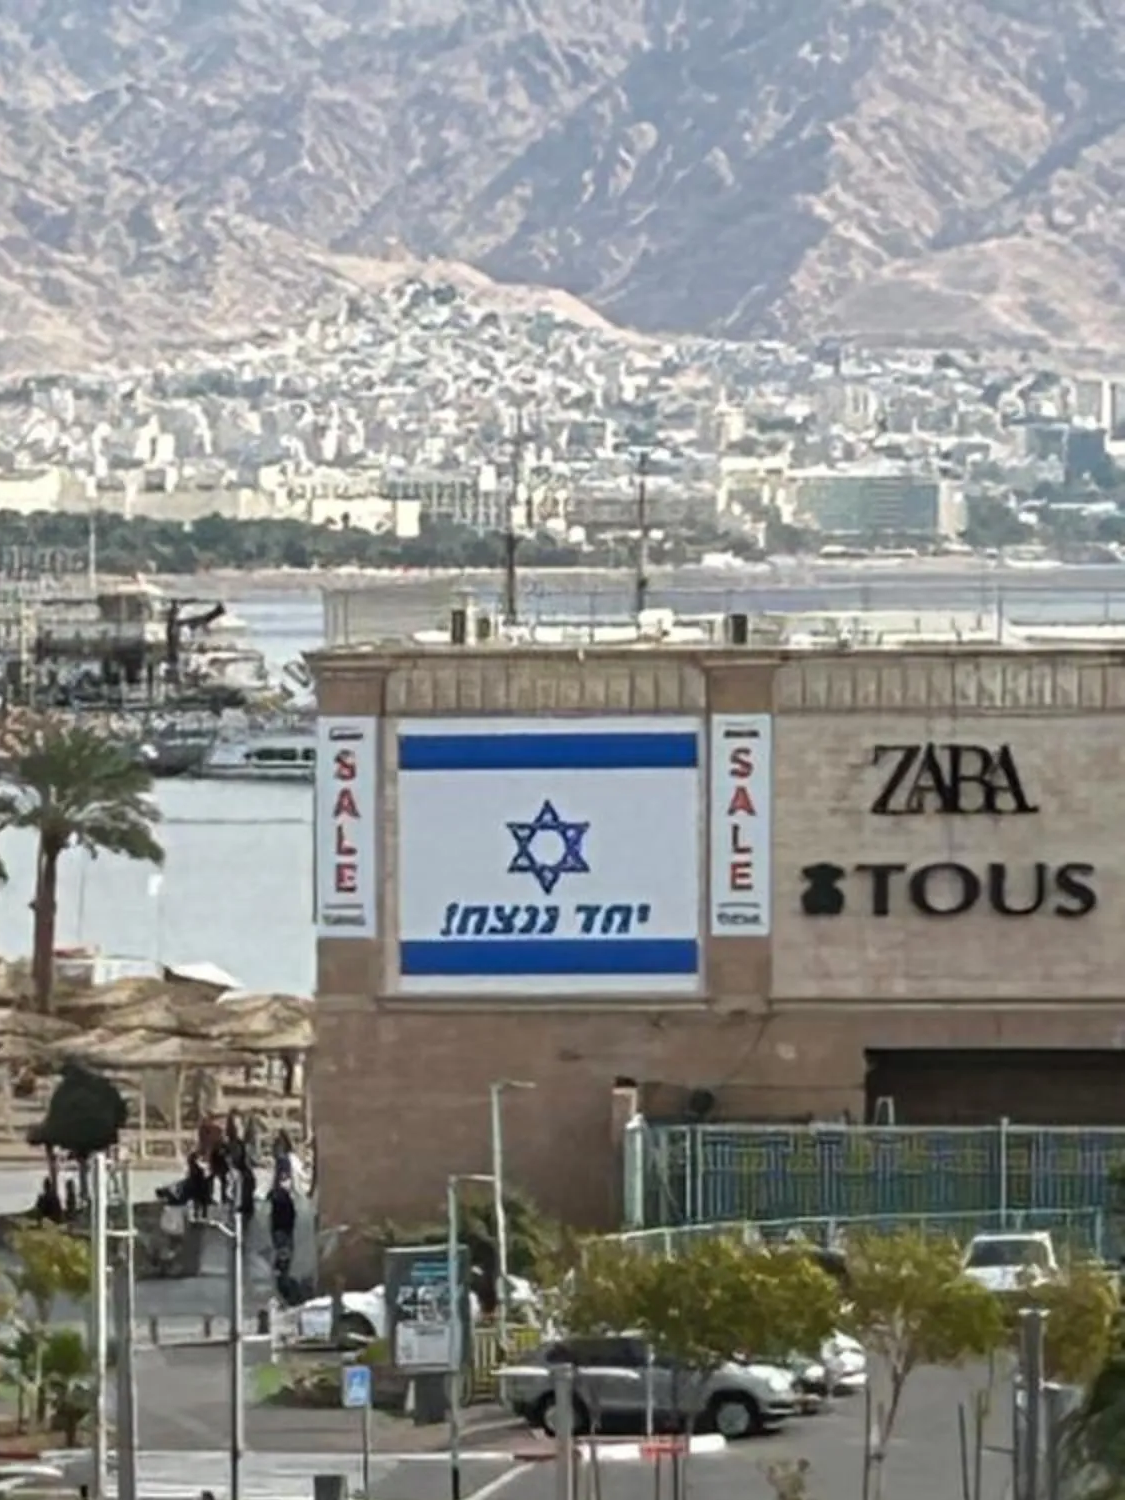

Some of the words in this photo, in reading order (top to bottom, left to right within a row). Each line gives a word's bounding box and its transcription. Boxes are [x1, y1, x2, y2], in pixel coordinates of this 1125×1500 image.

[871, 742, 1039, 815] ZARA
[333, 748, 361, 893] SALE
[727, 747, 756, 891] SALE
[575, 904, 651, 934] יחד
[855, 862, 1096, 917] TOUS
